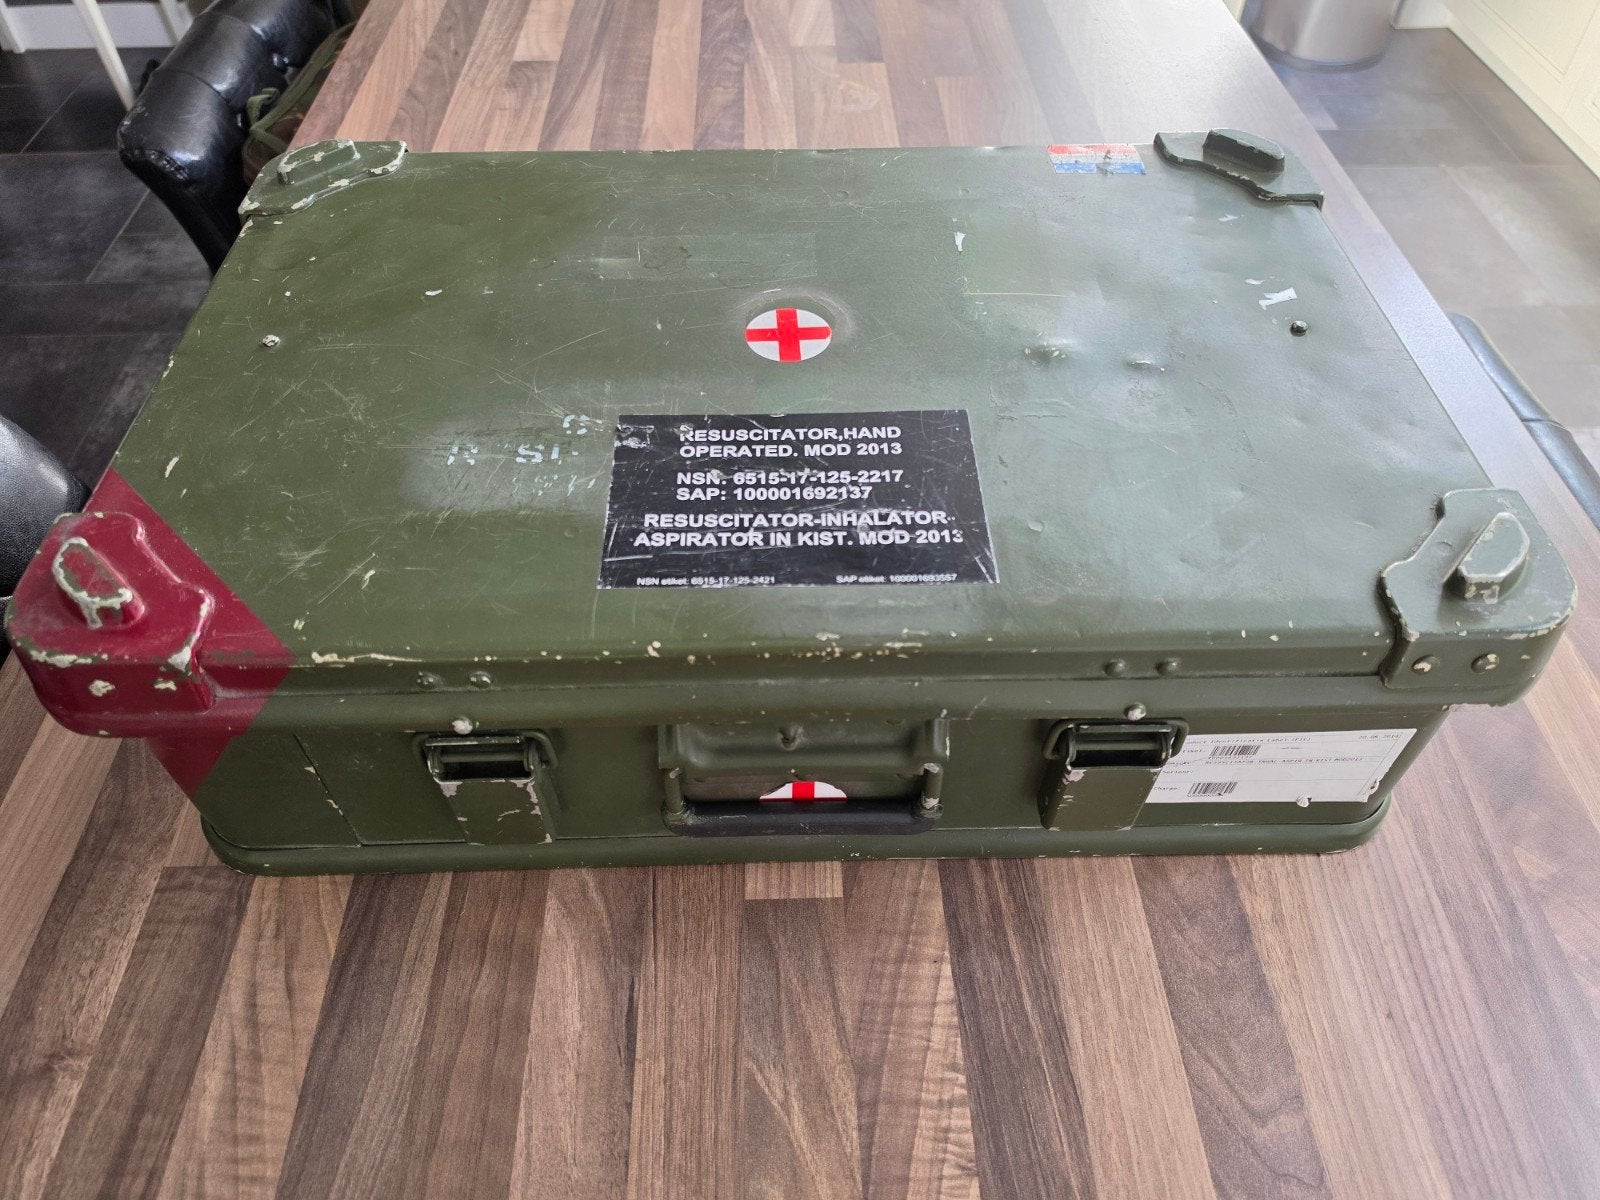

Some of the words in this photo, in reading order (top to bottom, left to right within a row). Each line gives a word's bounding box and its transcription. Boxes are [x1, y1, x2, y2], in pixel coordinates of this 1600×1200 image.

[679, 444, 799, 458] OPERATED.
[804, 443, 852, 457] MOD
[856, 442, 903, 456] 2013
[732, 469, 904, 485] 6515-17-125-2217
[676, 487, 726, 500] SAP:
[733, 485, 873, 500] 100001692137
[633, 531, 764, 547] ASPIRATOR
[769, 532, 791, 546] IN
[797, 531, 853, 546] KIST.
[858, 530, 911, 546] MOD
[915, 529, 964, 544] 2013
[636, 577, 660, 586] NSN
[836, 575, 857, 584] SAP
